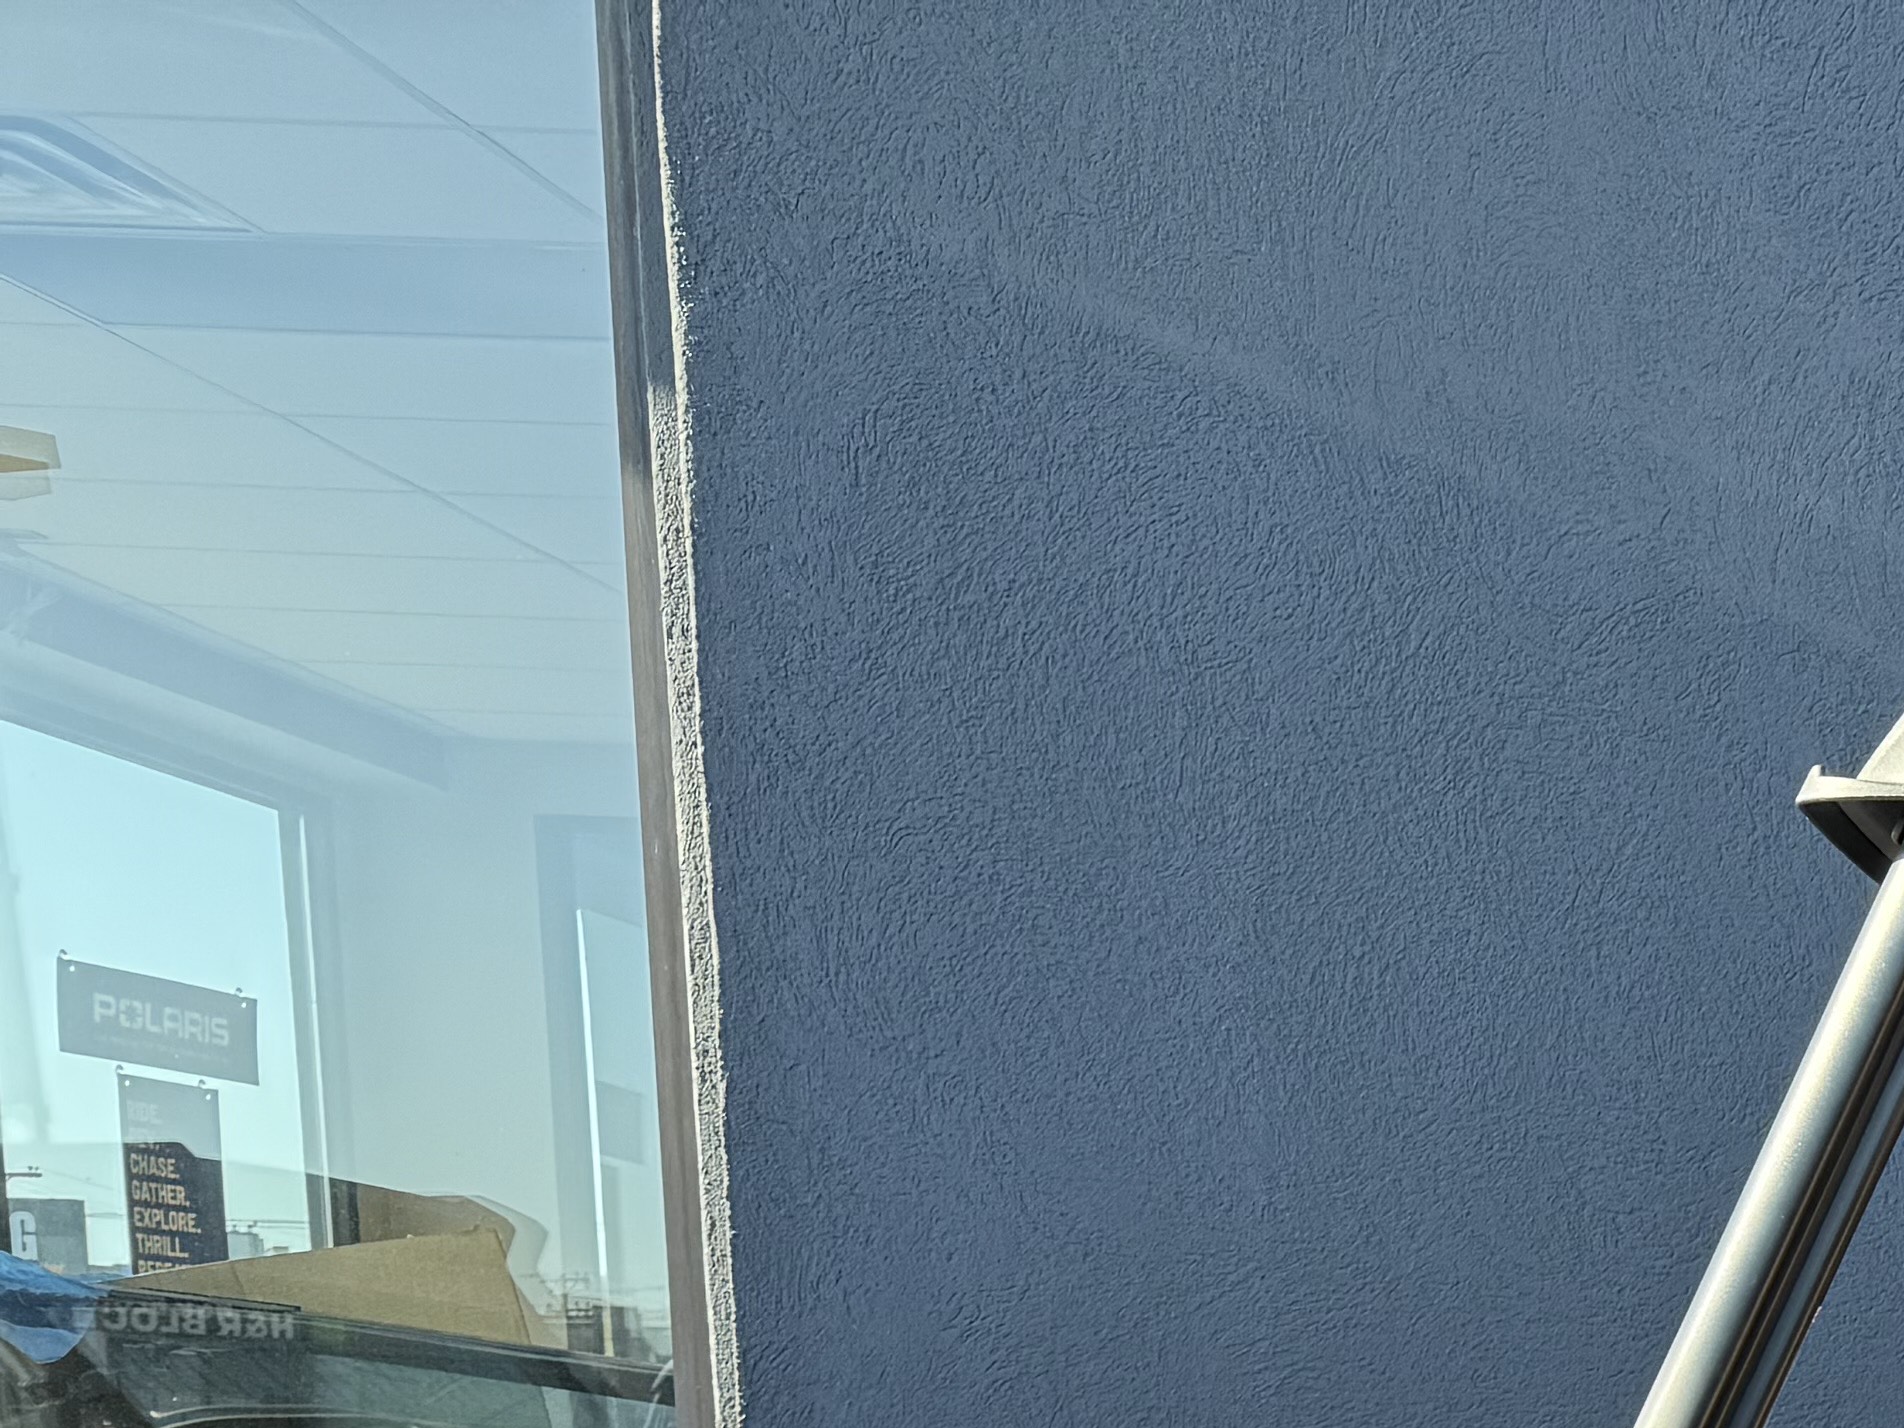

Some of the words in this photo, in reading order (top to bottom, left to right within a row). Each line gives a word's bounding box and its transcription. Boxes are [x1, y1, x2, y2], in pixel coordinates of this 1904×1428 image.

[92, 992, 230, 1047] POLARIS
[130, 1153, 180, 1179] CHASE.
[131, 1180, 190, 1208] GATHER.
[133, 1207, 202, 1234] EXPLORE.
[135, 1233, 189, 1258] THRILL.
